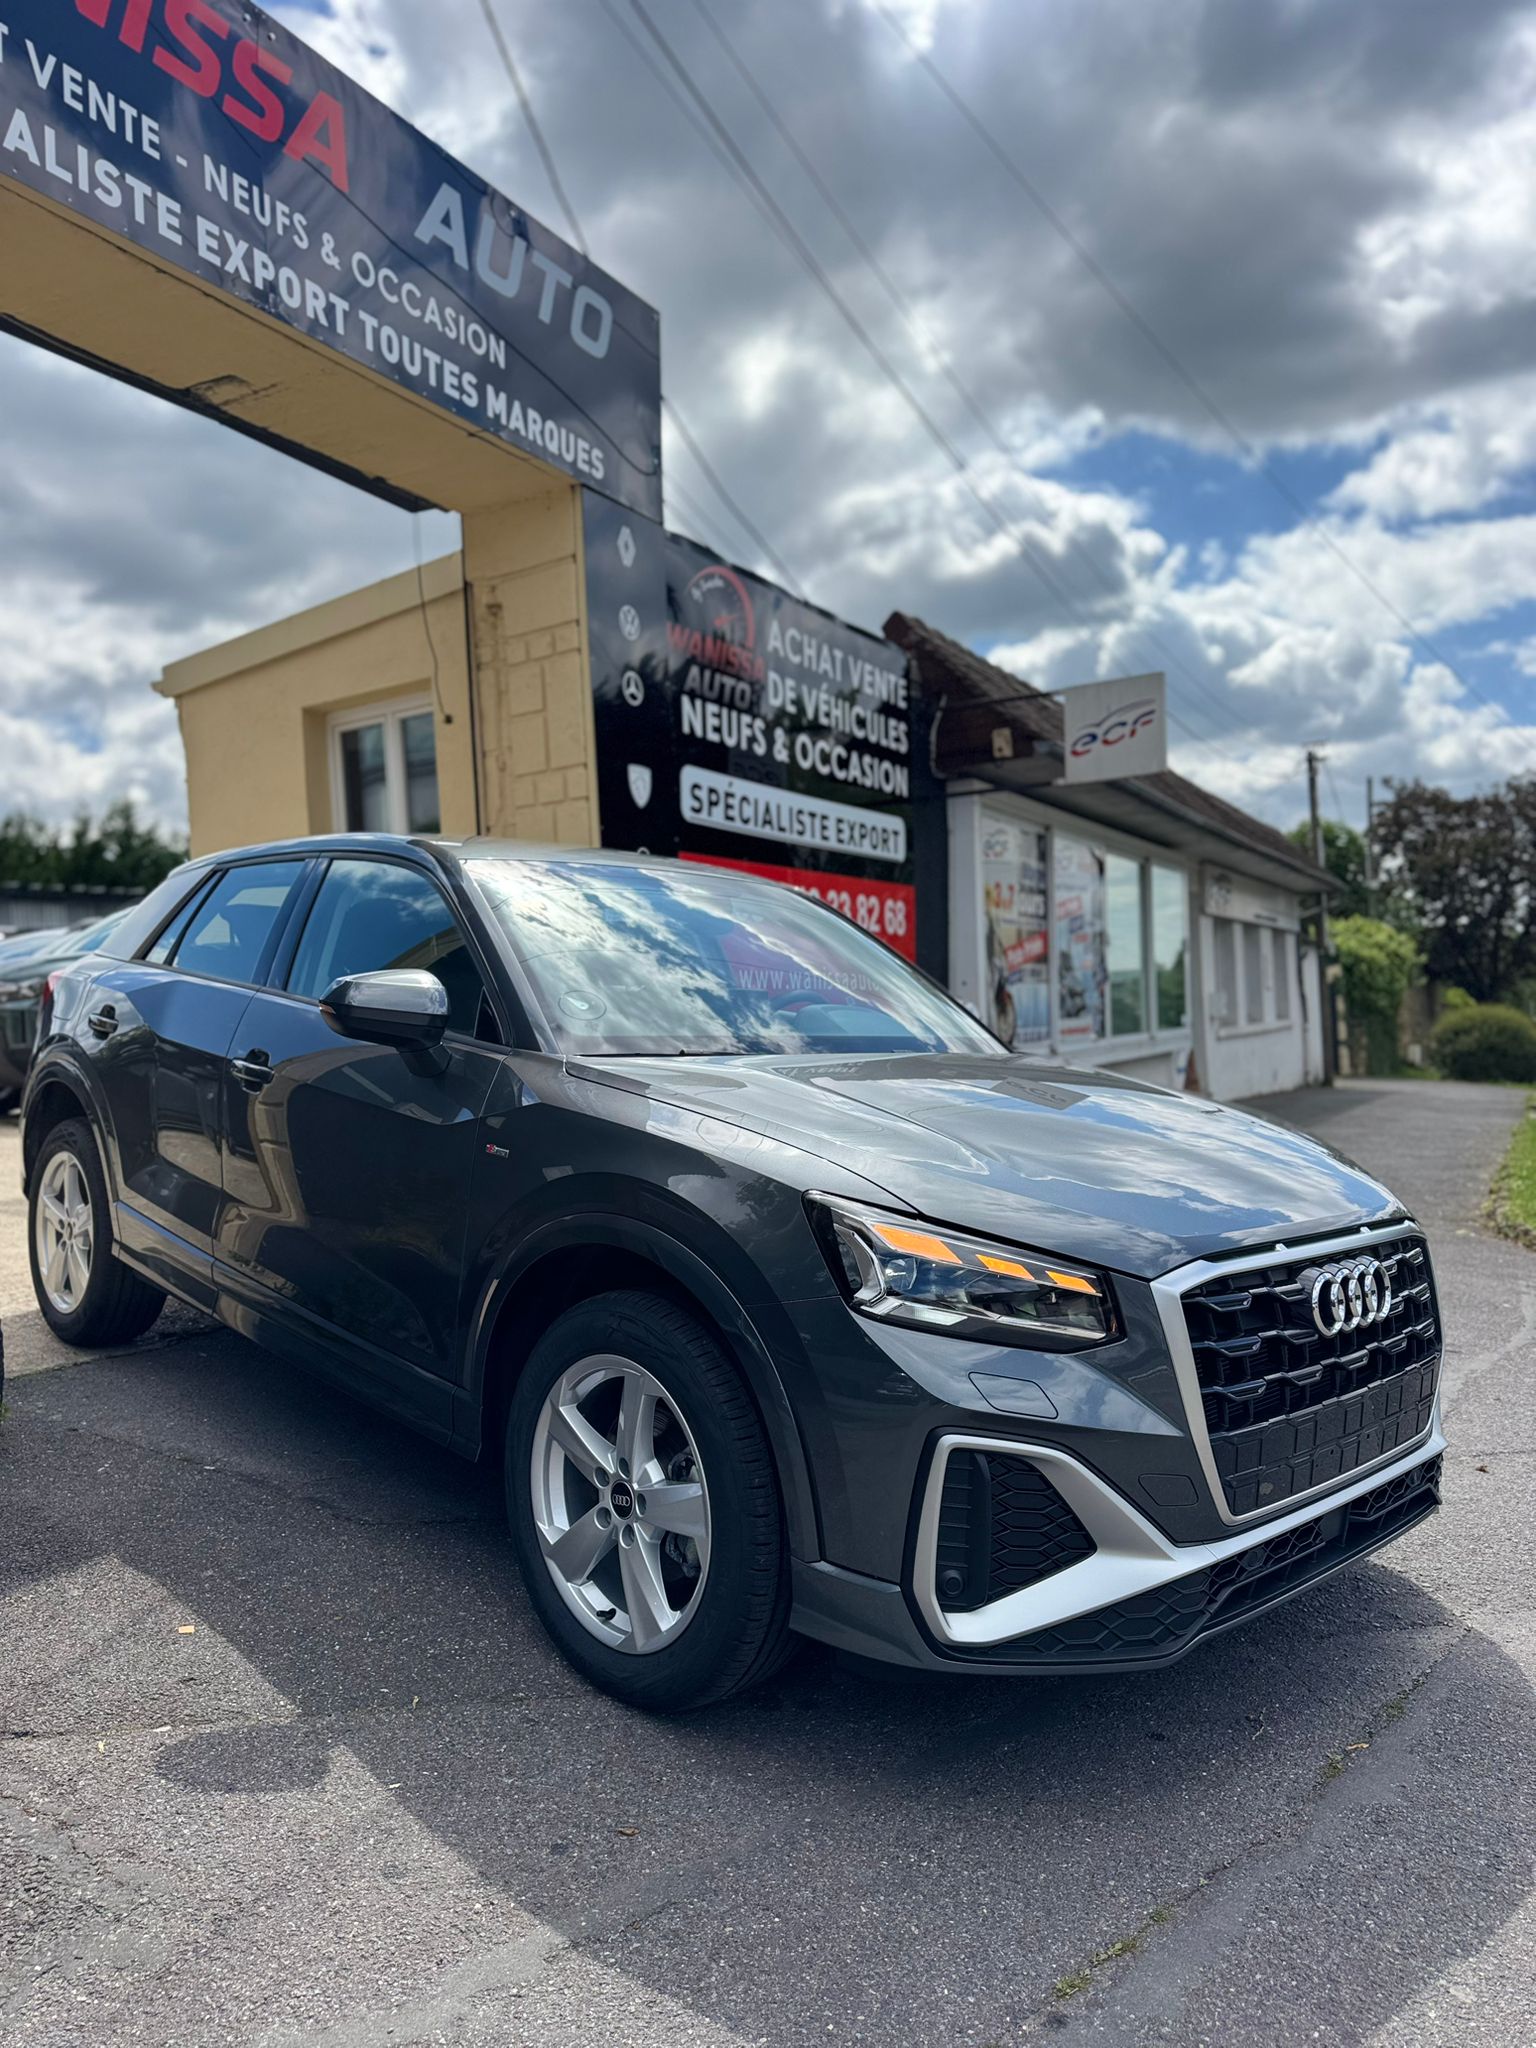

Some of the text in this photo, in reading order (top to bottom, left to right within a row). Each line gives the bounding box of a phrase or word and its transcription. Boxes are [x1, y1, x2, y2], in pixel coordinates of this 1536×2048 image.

[25, 38, 160, 161] VENTE
[203, 153, 309, 251] NEUFS
[321, 231, 342, 271] &
[352, 251, 506, 369] OCCASION
[2, 107, 605, 480] ALISTE EXPORT TOUTES MARQUES
[415, 183, 615, 359] AUTO
[666, 620, 765, 682] WANISSA
[683, 664, 752, 711] AUTO
[767, 620, 908, 709] ACHAT VENTE
[681, 696, 908, 798] NEUFS & OCCASION
[768, 670, 908, 755] DE VÉHICULES
[690, 779, 901, 855] SPÉCIALISTE EXPORT
[856, 893, 881, 933] 82
[884, 898, 907, 937] 68
